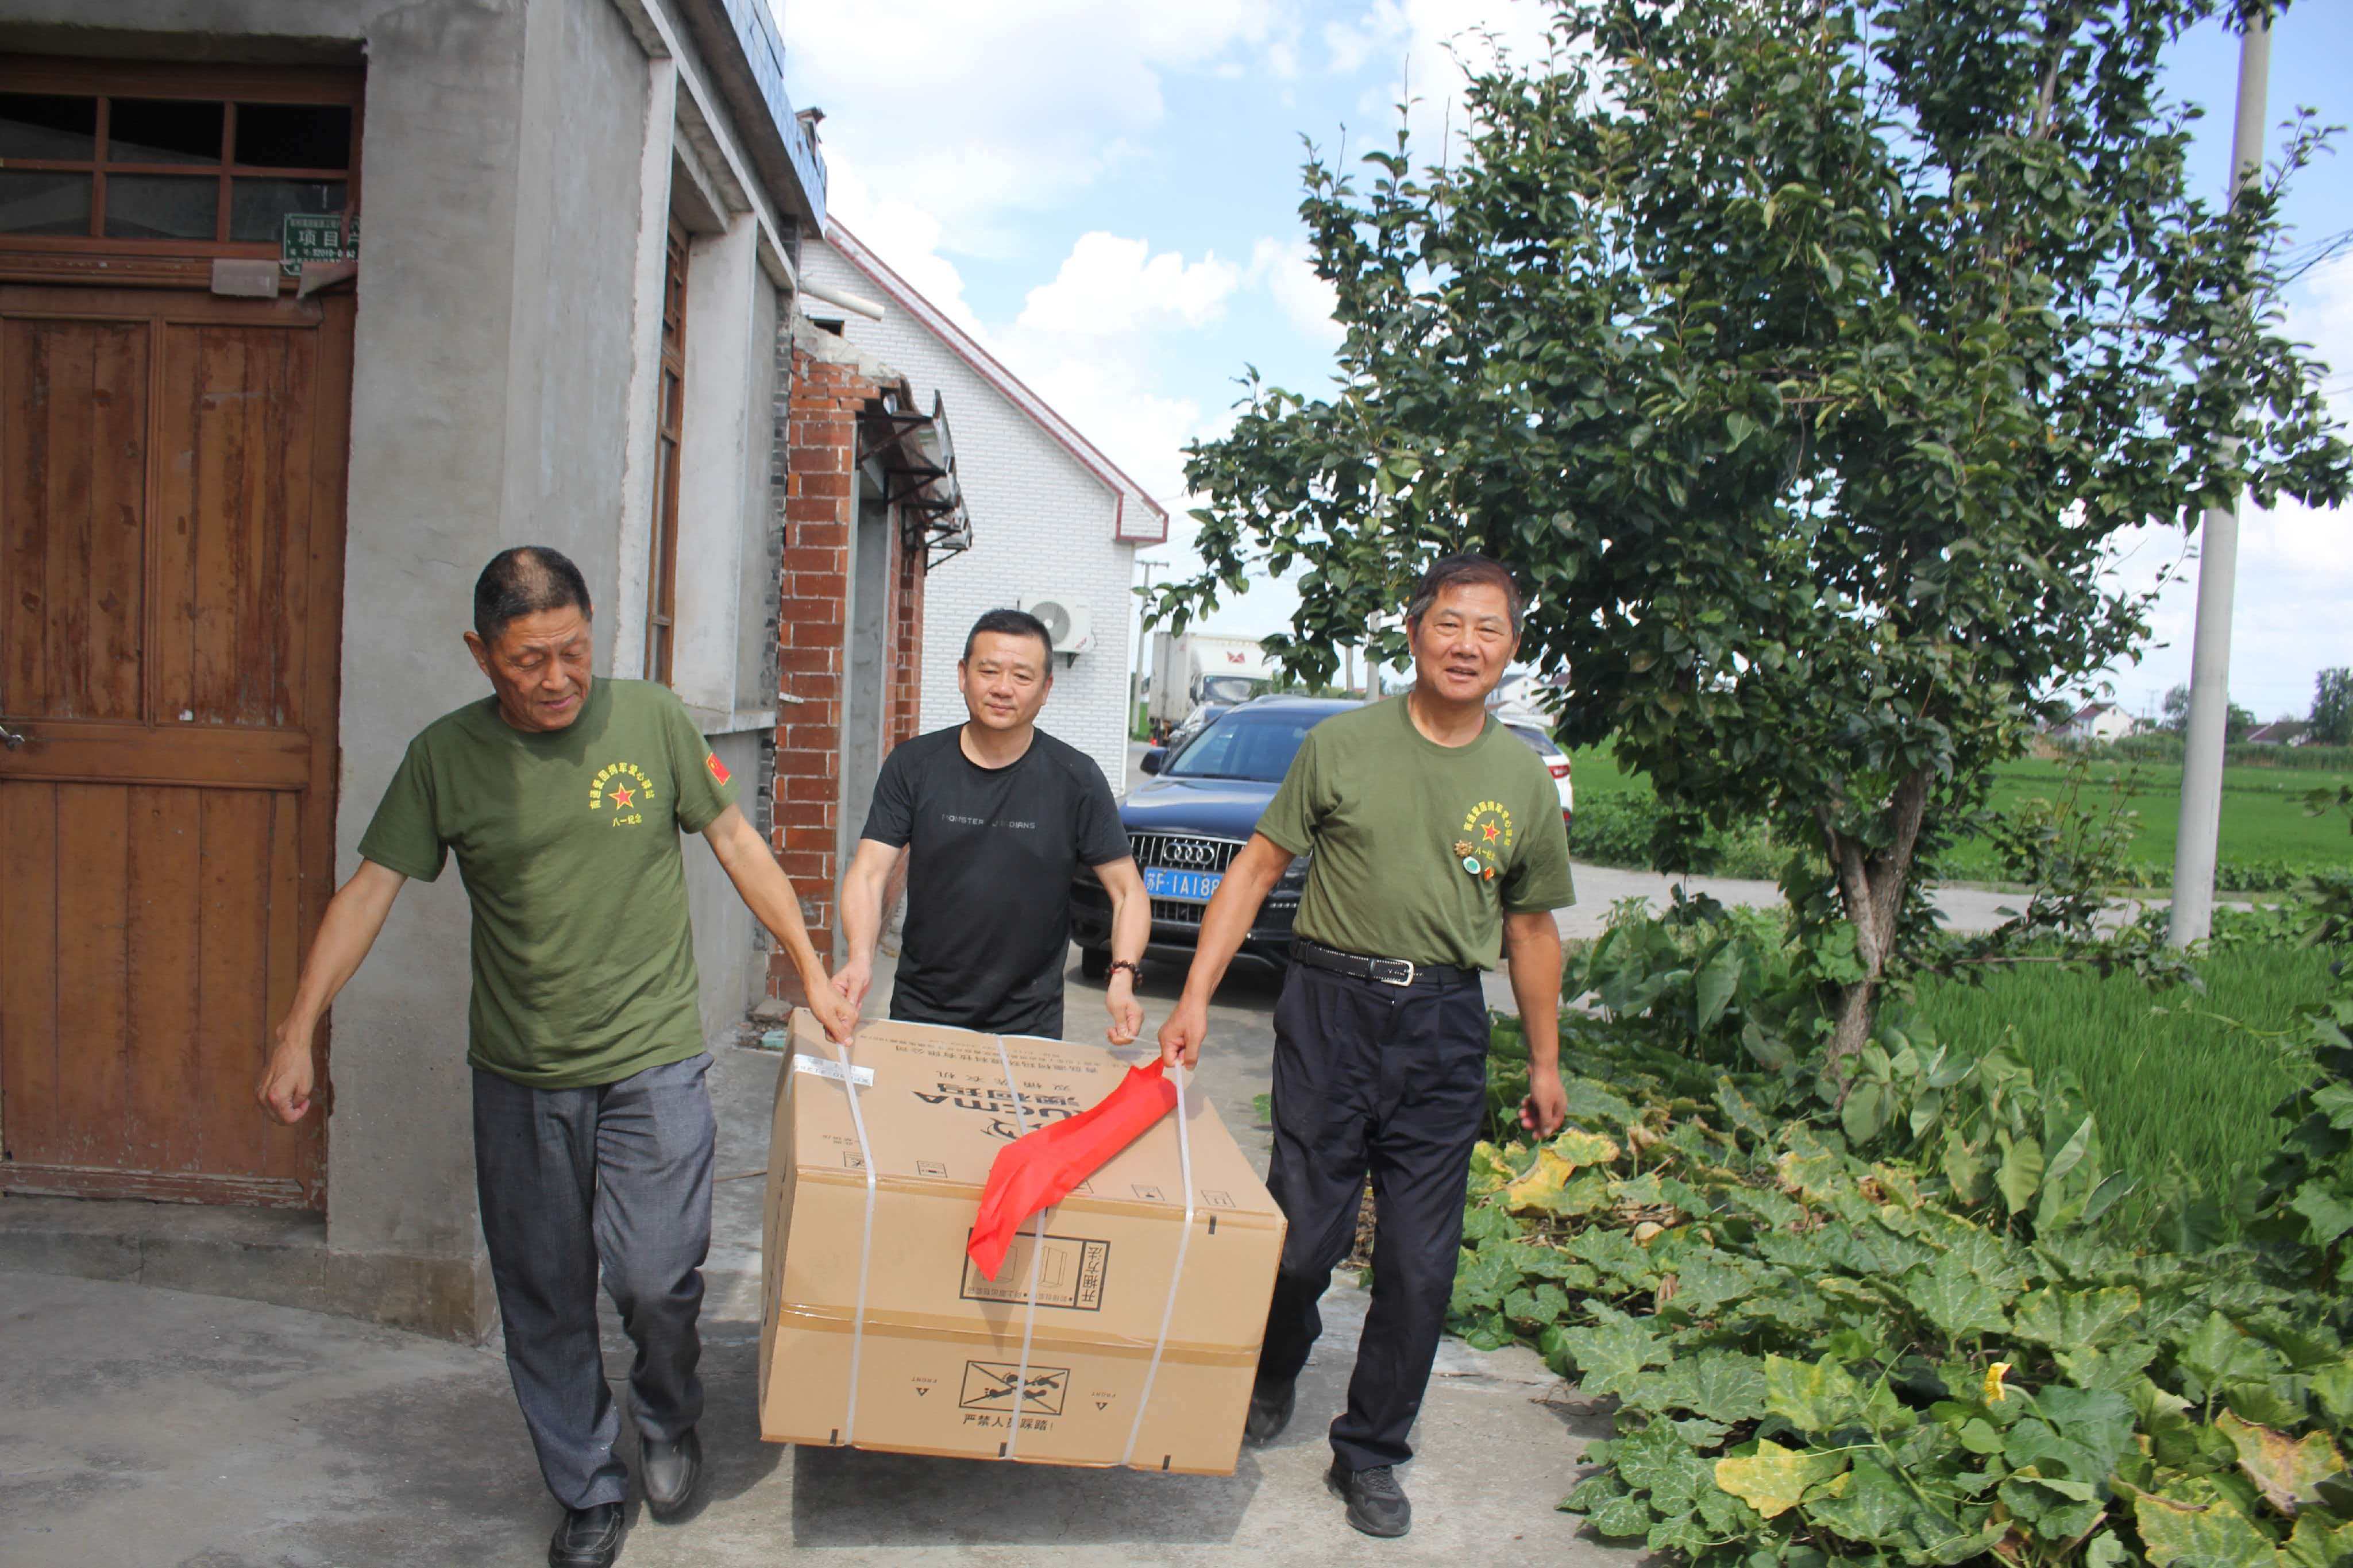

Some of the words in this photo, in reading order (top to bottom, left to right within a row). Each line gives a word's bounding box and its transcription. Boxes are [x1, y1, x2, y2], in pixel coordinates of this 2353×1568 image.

[612, 813, 642, 827] 八一纪念
[936, 1083, 1081, 1107] 澳柯玛
[1081, 1245, 1103, 1302] 开捆方法
